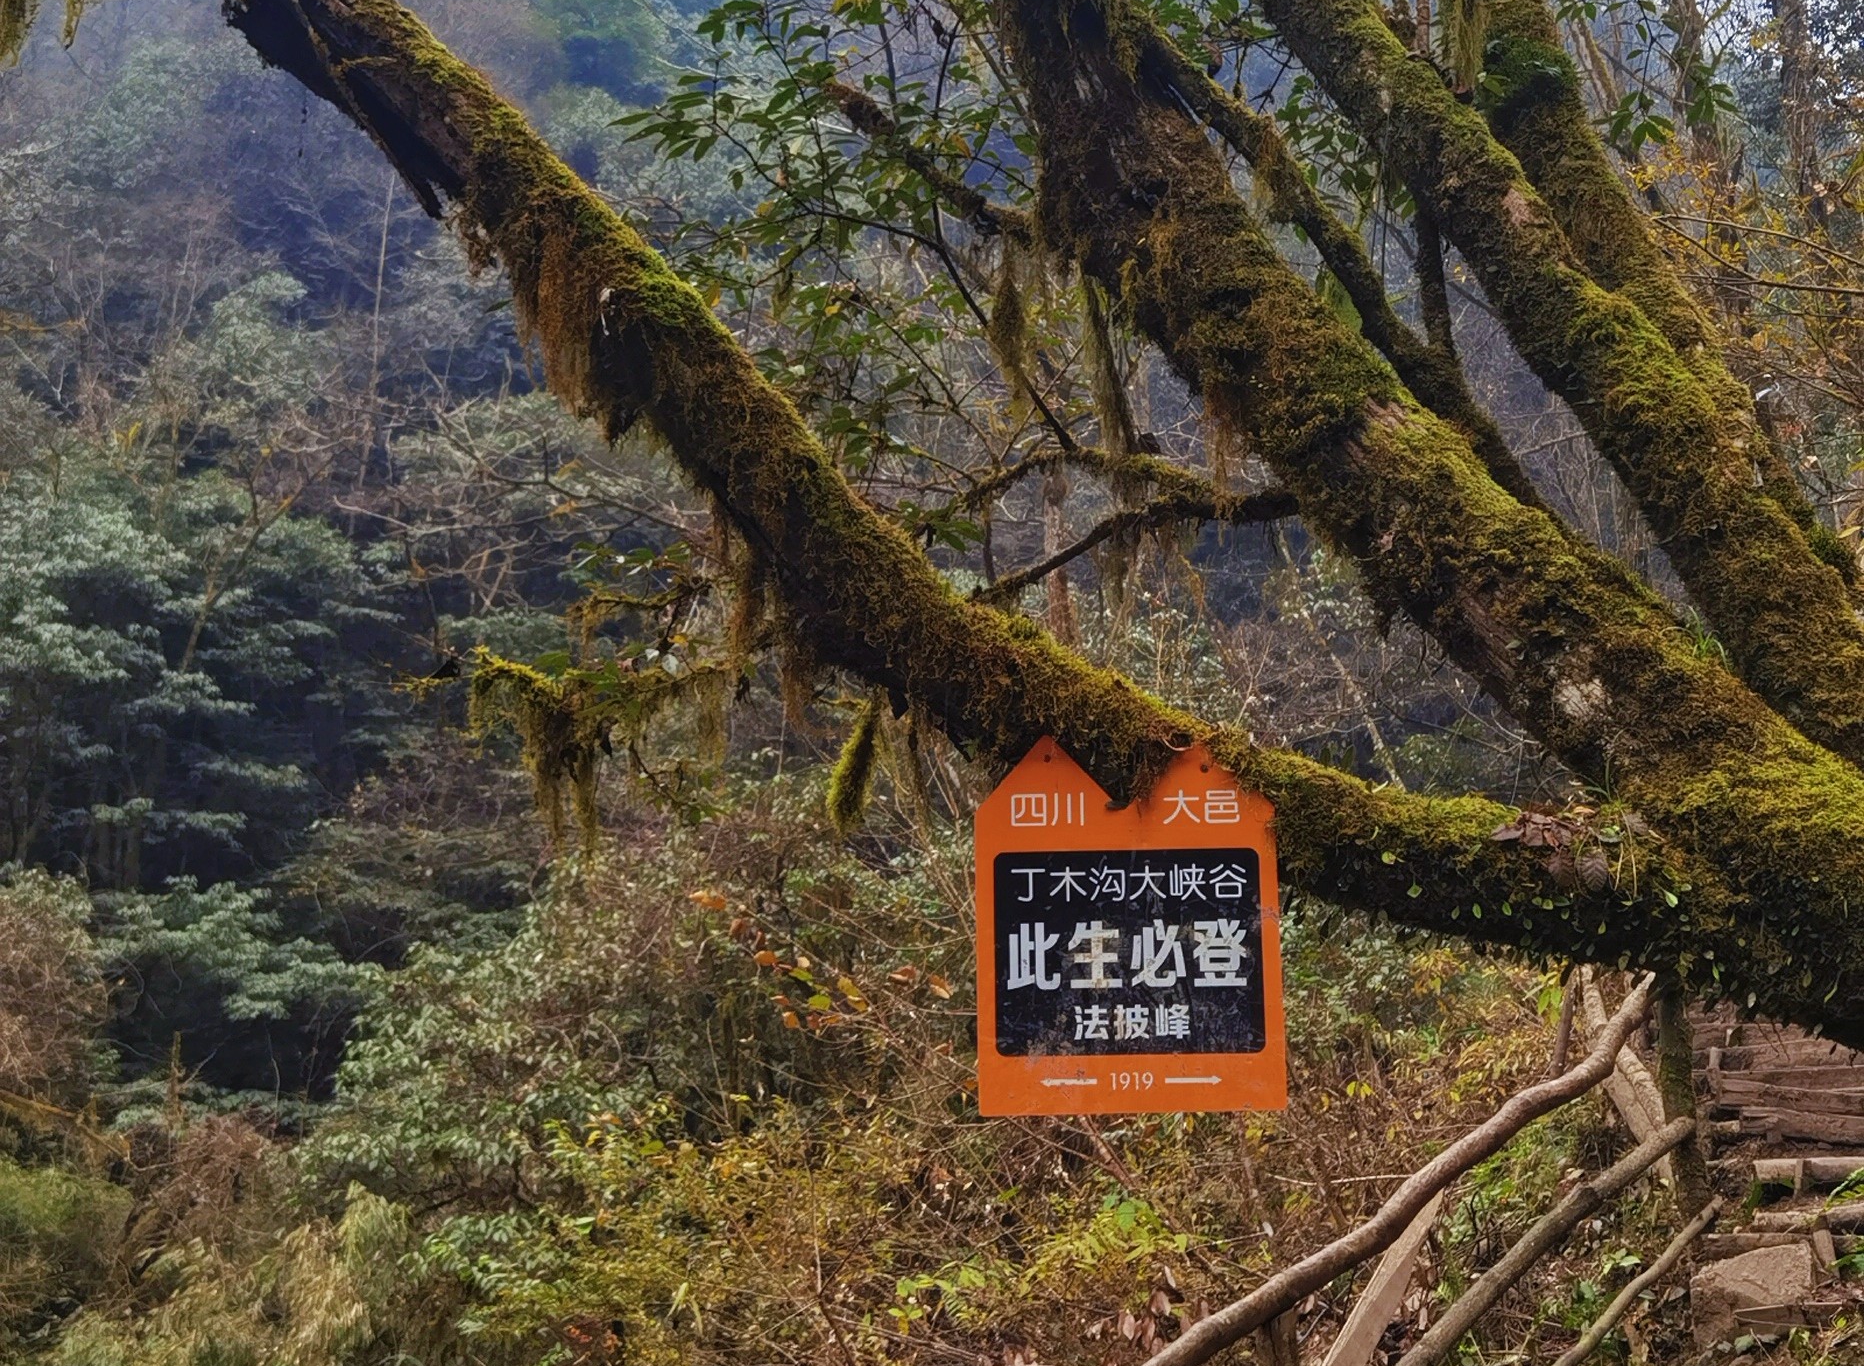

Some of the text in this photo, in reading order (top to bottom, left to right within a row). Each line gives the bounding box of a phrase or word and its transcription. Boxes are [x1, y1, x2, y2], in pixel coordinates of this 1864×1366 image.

[1010, 789, 1241, 827] 四川 大邑
[1010, 863, 1248, 902] 丁木沟大峡谷
[1007, 918, 1248, 991] 此生必登
[1073, 1003, 1191, 1041] 法披峰
[1109, 1072, 1154, 1091] 1919
